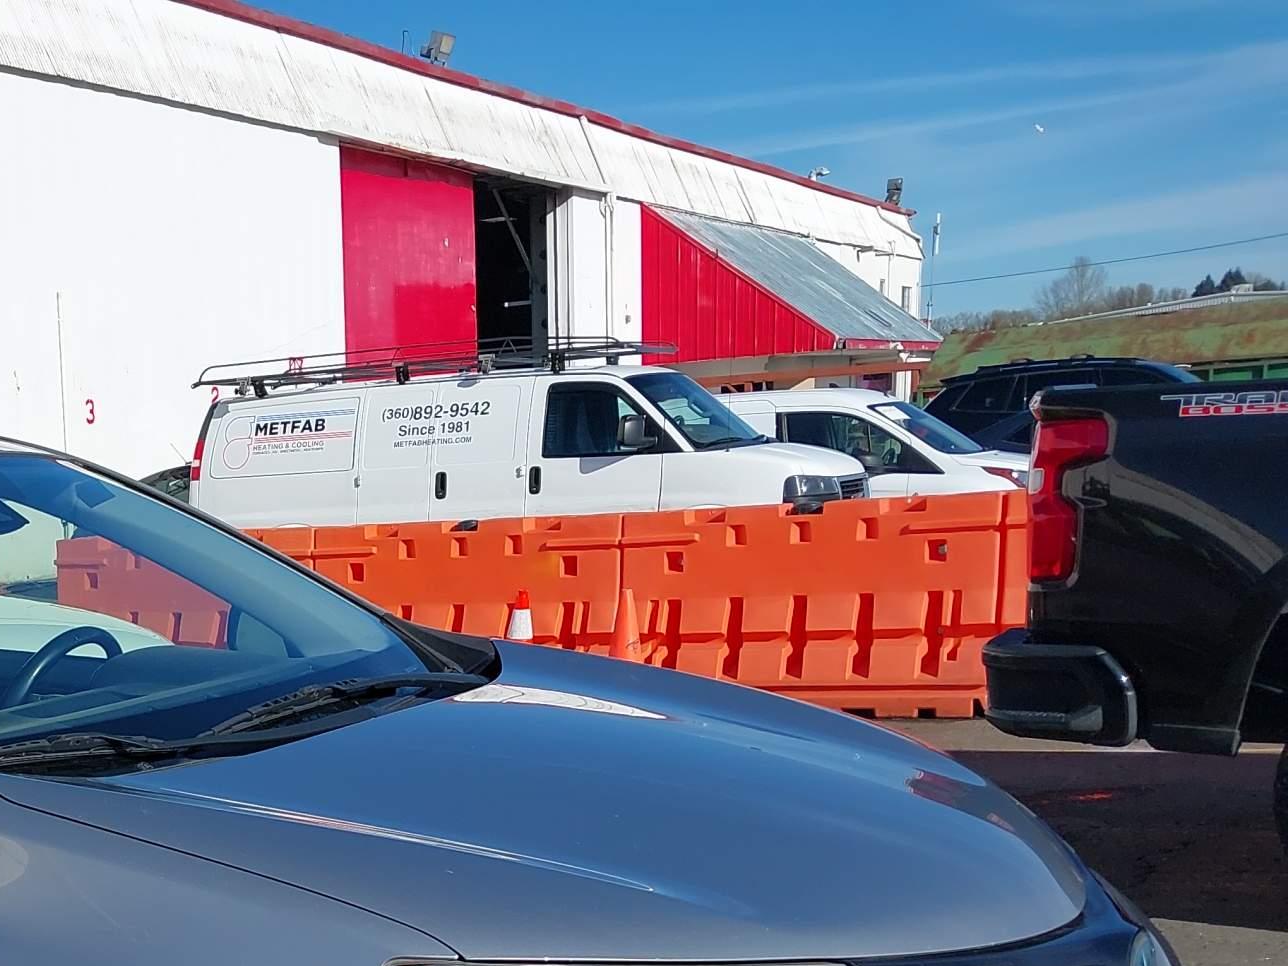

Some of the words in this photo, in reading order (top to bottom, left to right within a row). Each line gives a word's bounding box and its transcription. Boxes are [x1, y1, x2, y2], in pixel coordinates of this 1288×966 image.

[85, 399, 95, 424] 3
[382, 401, 490, 422] (360)892-9542
[255, 419, 326, 436] METFAB
[398, 425, 435, 437] Since
[441, 421, 469, 434] 1981
[253, 443, 284, 451] HEATING
[292, 440, 324, 449] COOLING
[394, 437, 472, 448] METFABHEATING.COM
